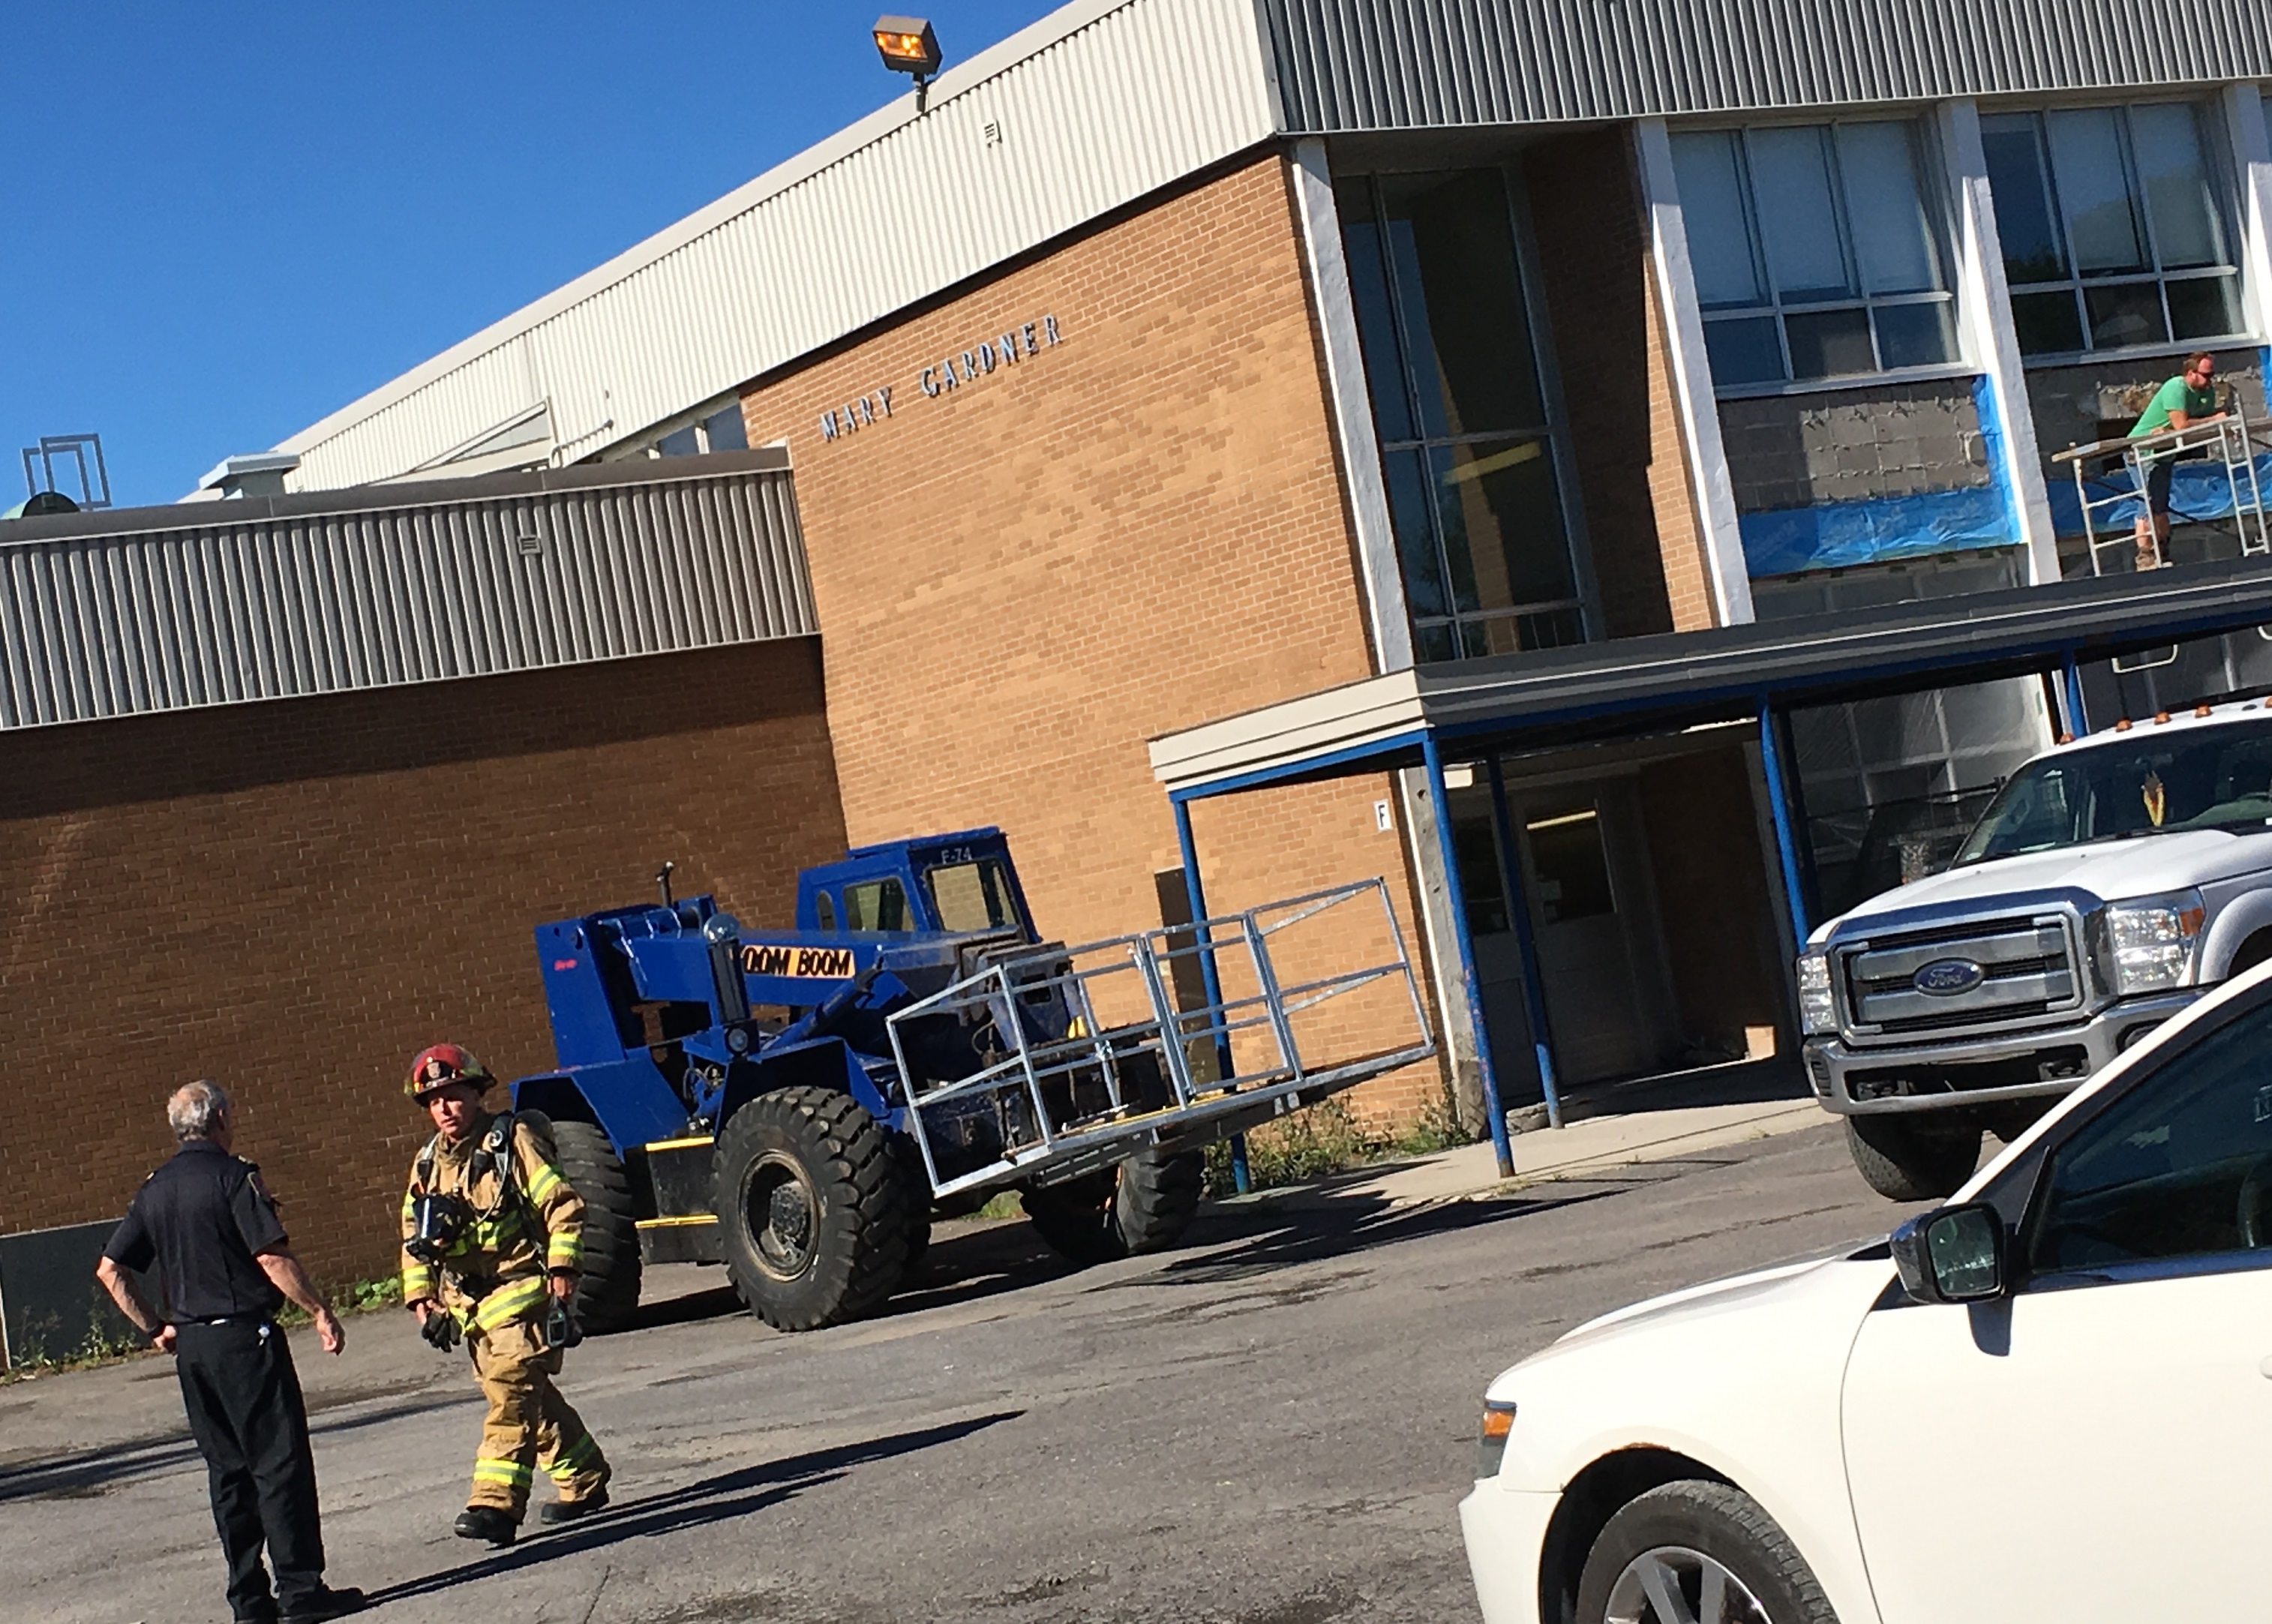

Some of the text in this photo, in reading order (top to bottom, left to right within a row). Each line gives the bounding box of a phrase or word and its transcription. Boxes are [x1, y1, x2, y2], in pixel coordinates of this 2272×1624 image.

[820, 315, 1064, 443] MARY GARDNER
[742, 947, 851, 976] OOM BOOM
[1928, 967, 1963, 986] Ford
